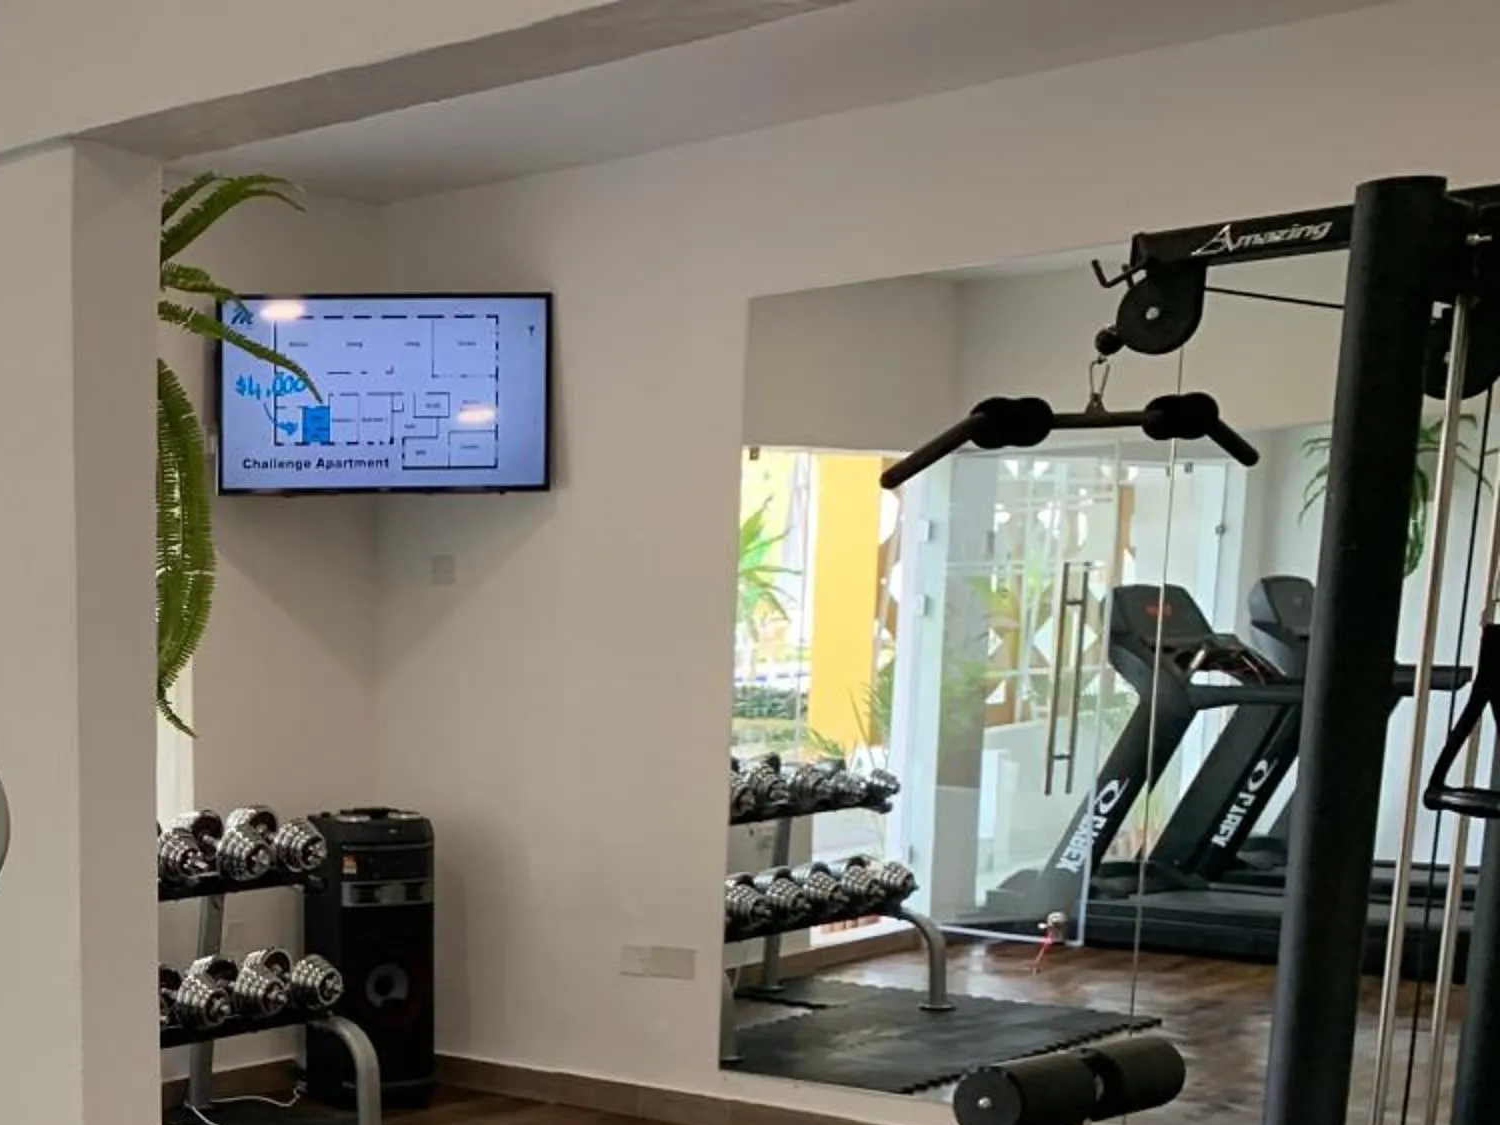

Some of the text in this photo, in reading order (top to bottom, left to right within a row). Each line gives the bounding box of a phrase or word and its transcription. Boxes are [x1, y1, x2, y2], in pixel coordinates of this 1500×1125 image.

[1191, 222, 1333, 257] Amazing
[243, 458, 389, 471] Challenge Apartment
